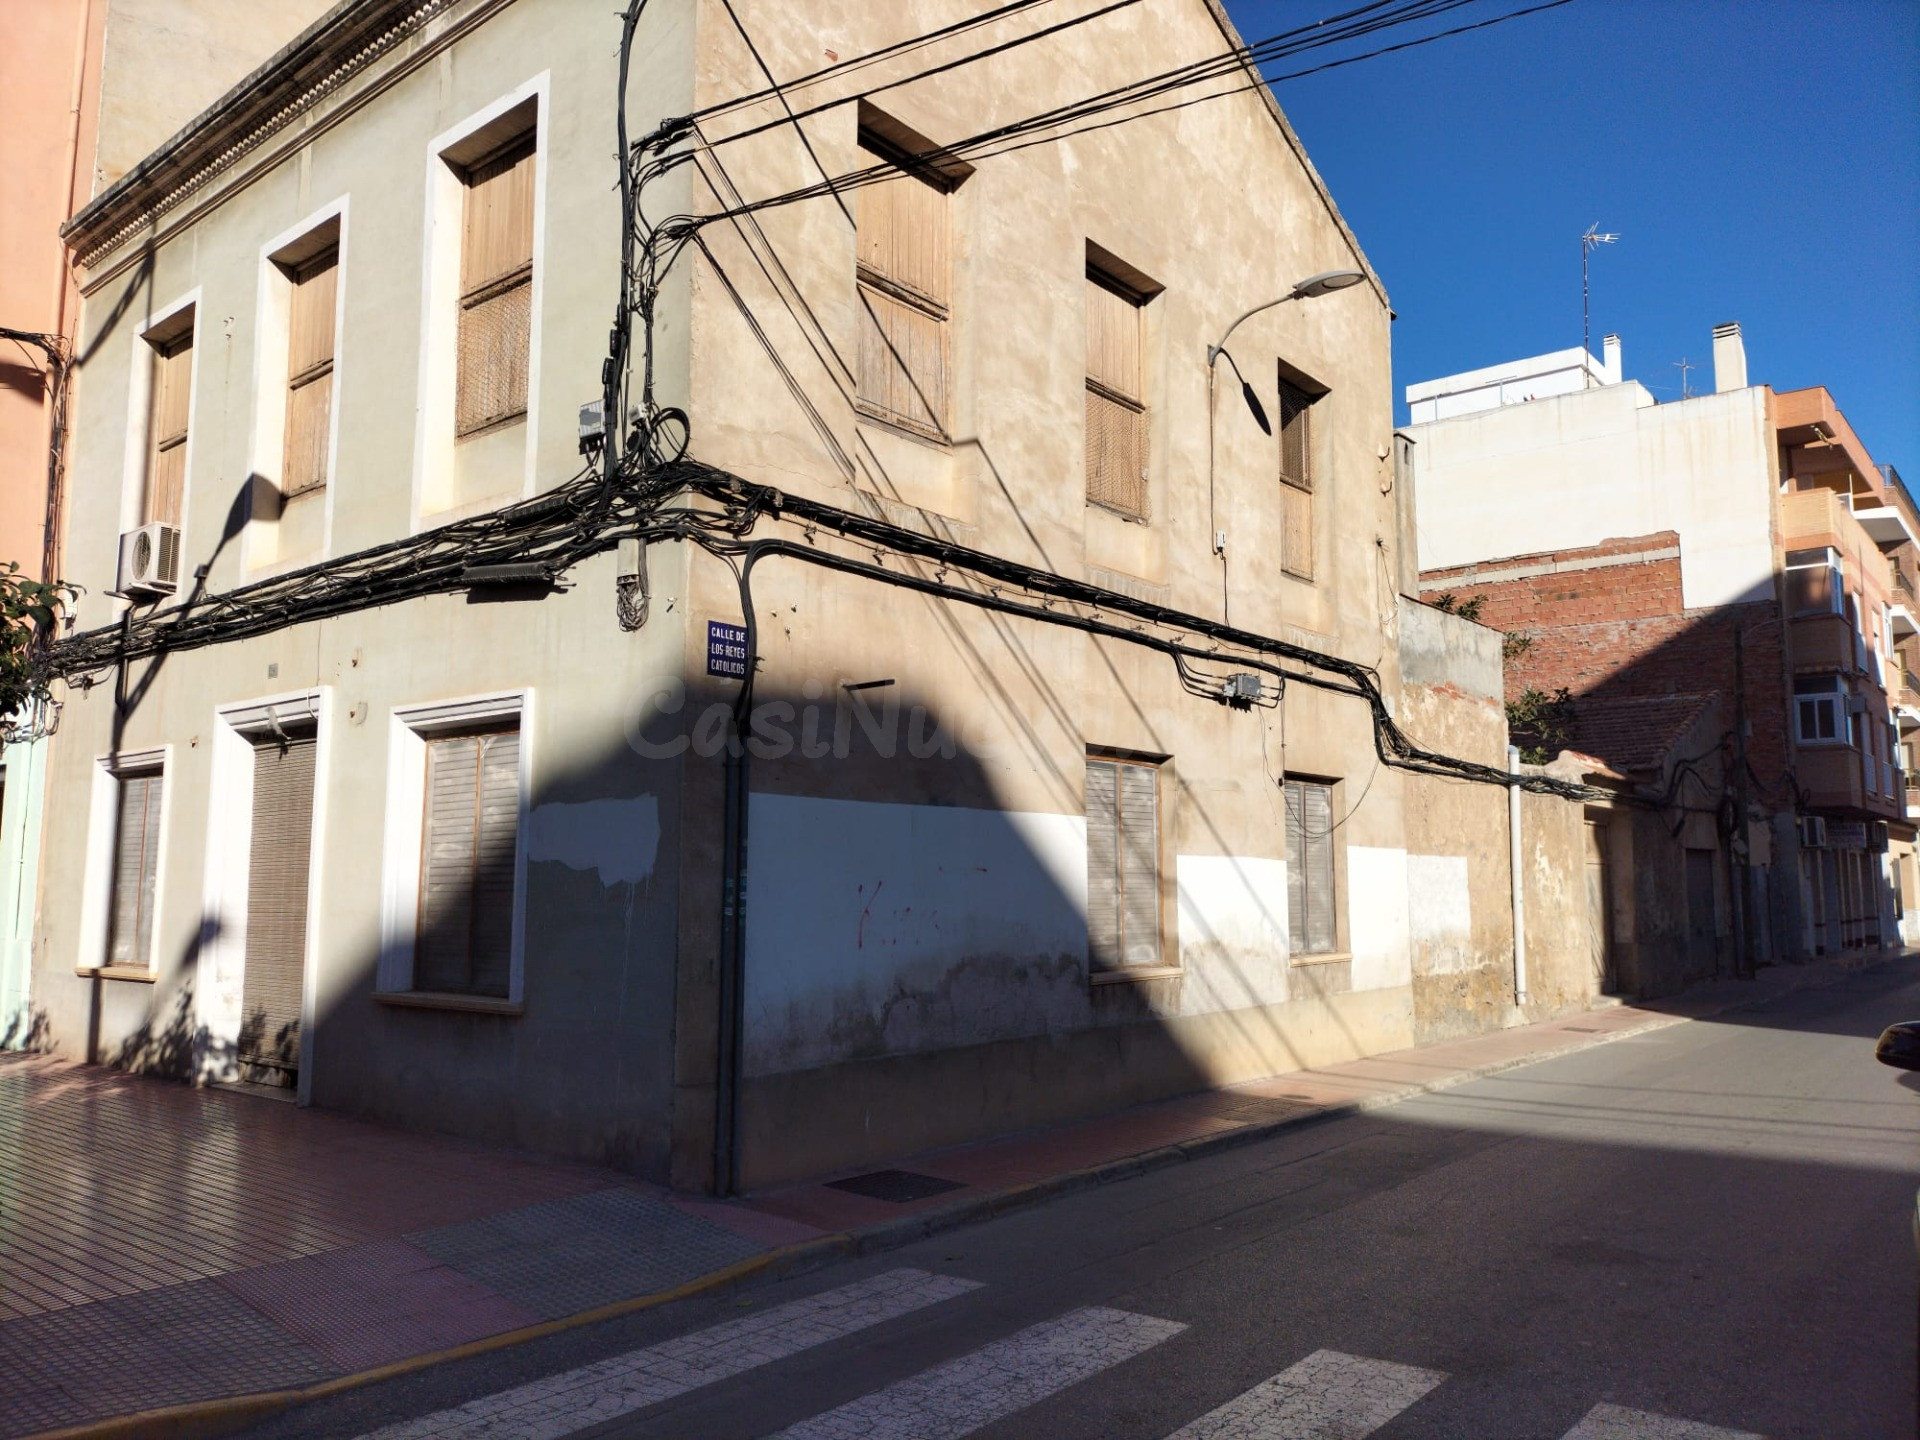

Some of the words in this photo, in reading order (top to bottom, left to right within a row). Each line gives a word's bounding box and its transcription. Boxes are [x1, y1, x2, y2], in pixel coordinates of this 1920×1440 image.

[711, 627, 734, 640] CALLE
[736, 631, 745, 642] DE
[711, 643, 724, 655] LOS
[725, 645, 745, 659] REYES
[711, 659, 745, 675] CATOLICOS
